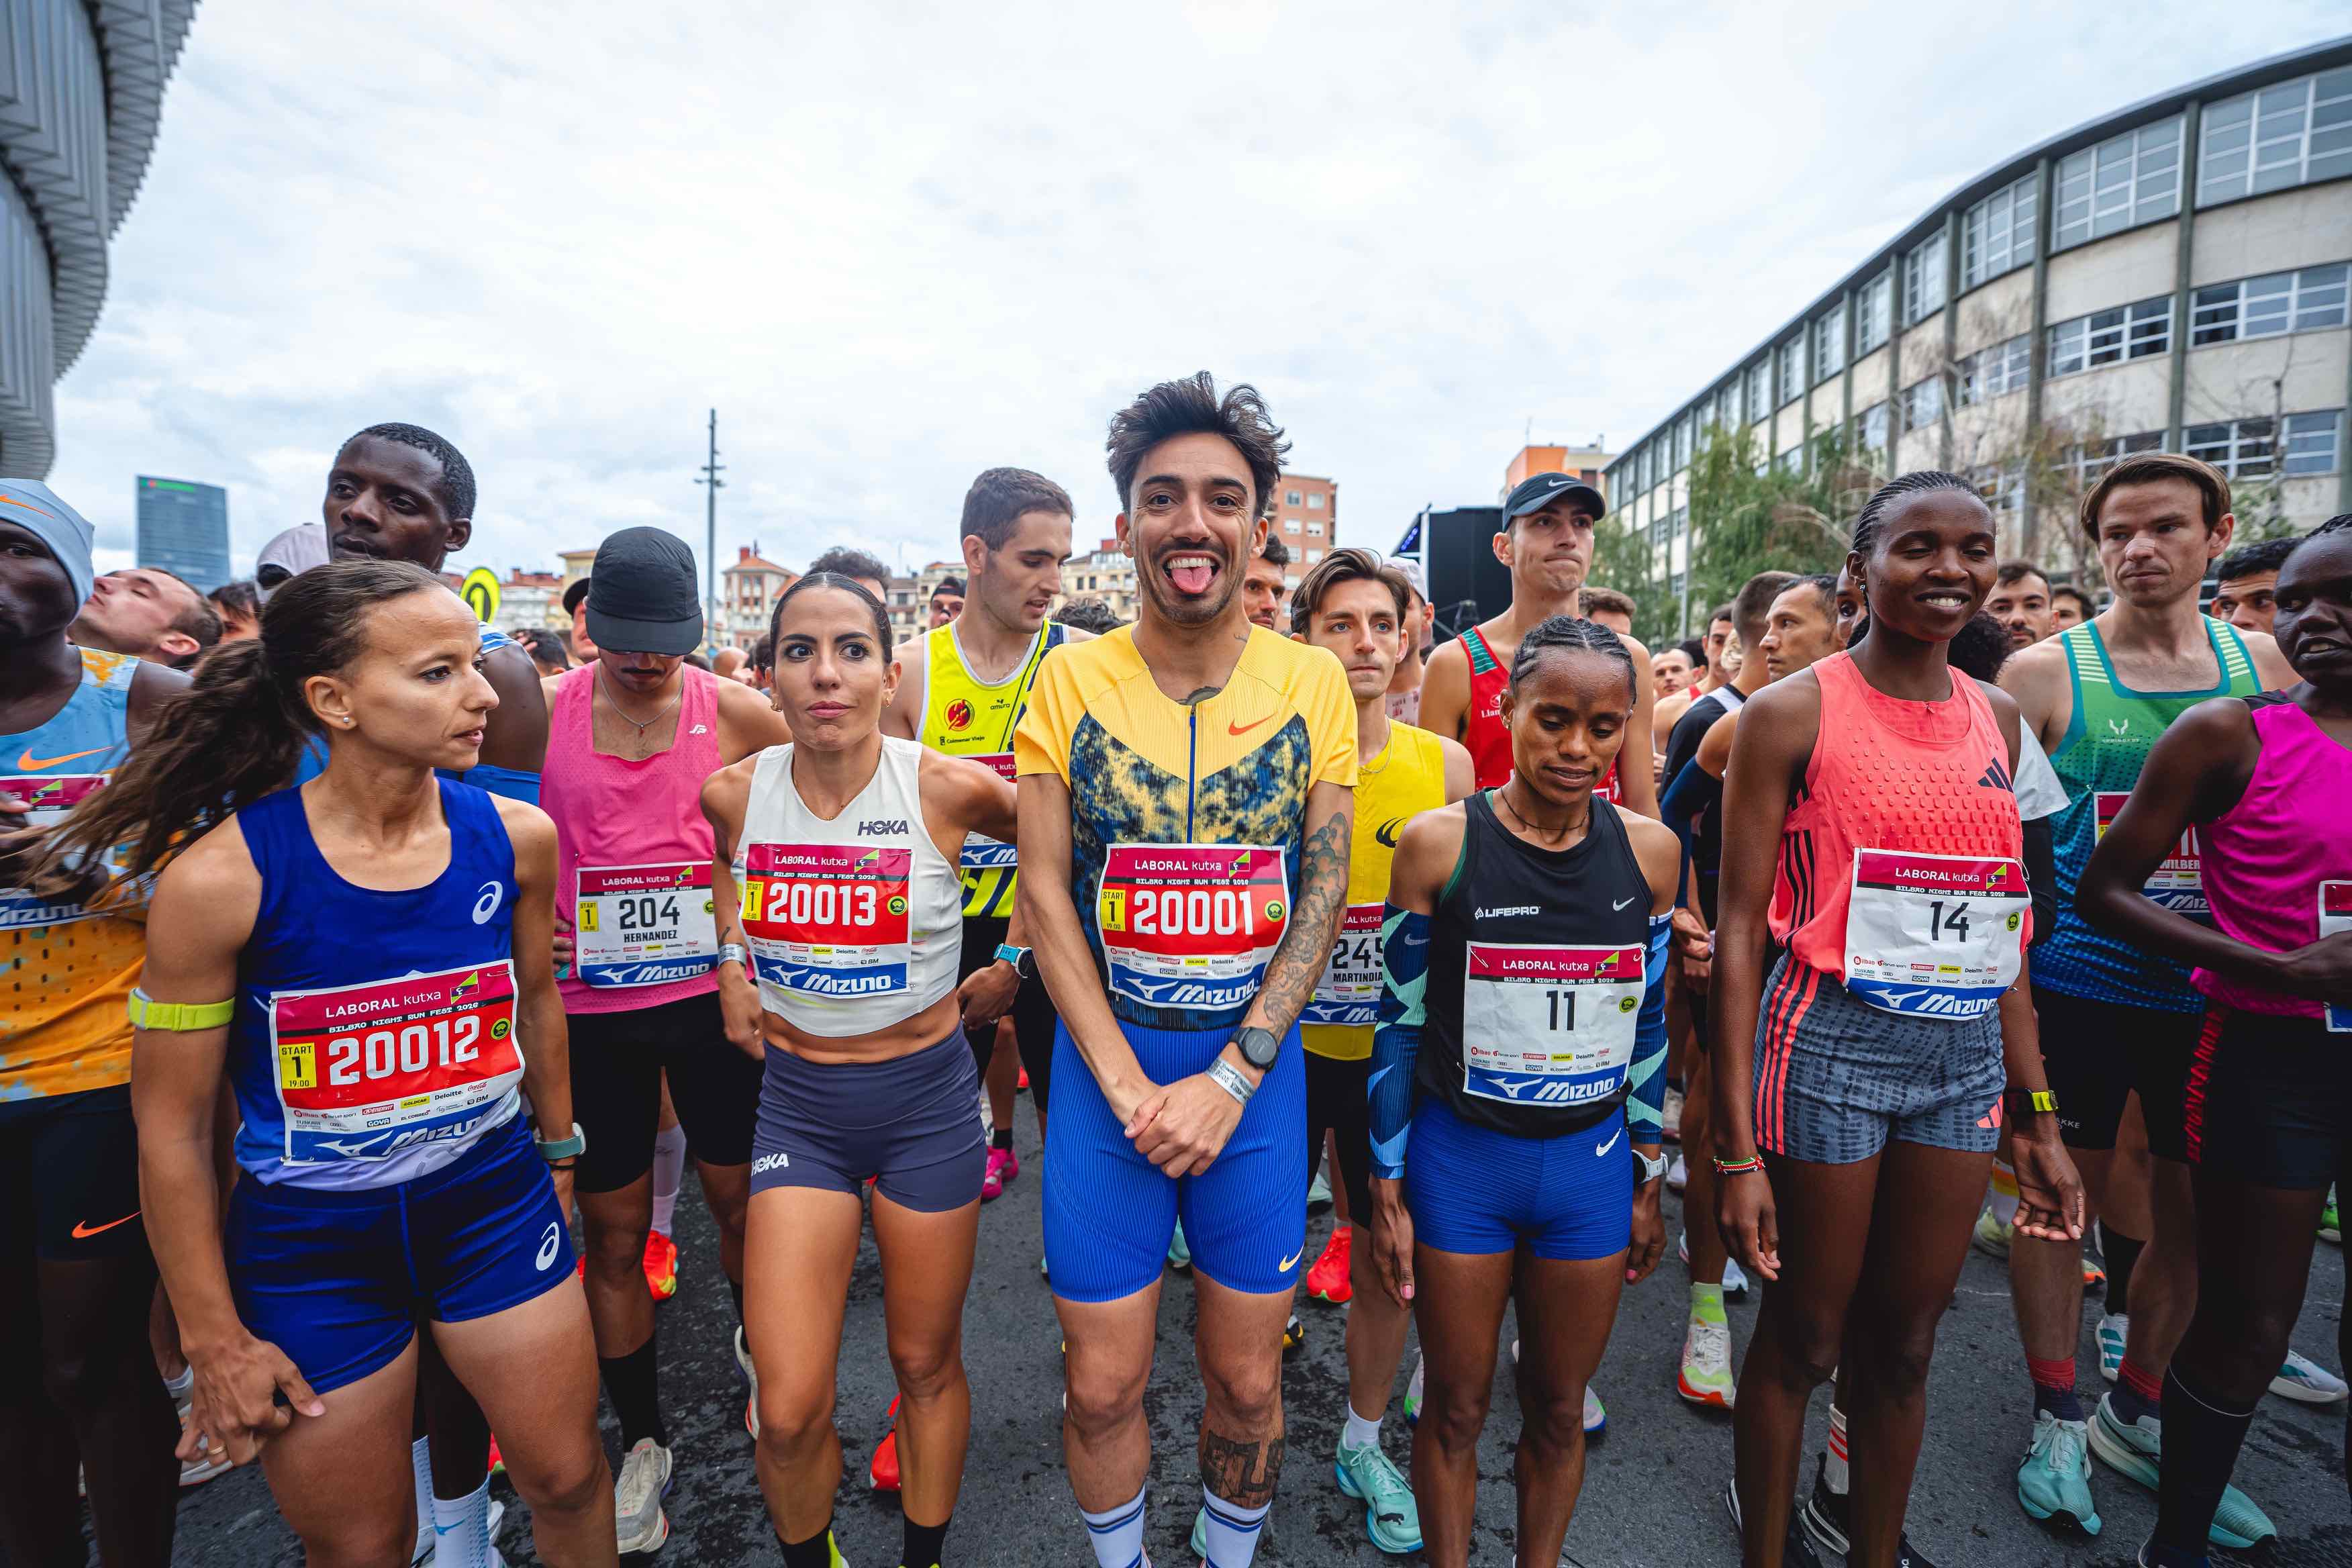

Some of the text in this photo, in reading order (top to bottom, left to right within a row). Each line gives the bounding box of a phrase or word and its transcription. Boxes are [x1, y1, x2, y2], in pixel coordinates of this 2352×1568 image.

[857, 820, 909, 836] HOKA
[775, 856, 848, 866] LABORAL kutxa
[1134, 860, 1222, 871] LABORAL kutxa
[602, 877, 644, 885] LABORAL
[1896, 868, 1979, 882] LABORAL kutxa
[1103, 892, 1124, 900] START
[1896, 885, 1925, 893] BILBAO
[750, 891, 754, 911] 1
[768, 883, 877, 926] 20013
[585, 910, 591, 924] 1
[619, 895, 680, 930] 204
[1109, 901, 1115, 922] 1
[1134, 890, 1254, 935] 20001
[1361, 915, 1381, 923] kutxa
[1485, 906, 1540, 918] LIFEPRO
[1930, 901, 1969, 942] 14
[624, 930, 677, 943] HERNANDEZ
[1503, 960, 1589, 971] LABORAL kutxa
[1854, 956, 1875, 965] Bilbao
[634, 963, 709, 982] MIZUNO
[803, 973, 891, 993] MIZUNO
[1169, 979, 1255, 1005] MIZUNO
[326, 990, 441, 1018] LABORAL kutxa
[1546, 990, 1575, 1031] 11
[1916, 993, 1998, 1014] MIZUN
[329, 1002, 479, 1033] BILBAO NIGHT RUN FEST 2026
[281, 1045, 311, 1055] START
[328, 1015, 480, 1085] 20012
[291, 1057, 302, 1077] 1
[289, 1079, 309, 1087] 19:00
[1534, 1077, 1615, 1100] MIZUNO
[403, 1098, 427, 1106] GOLDCAR
[476, 1095, 489, 1103] BM
[751, 1153, 789, 1177] HOKA
